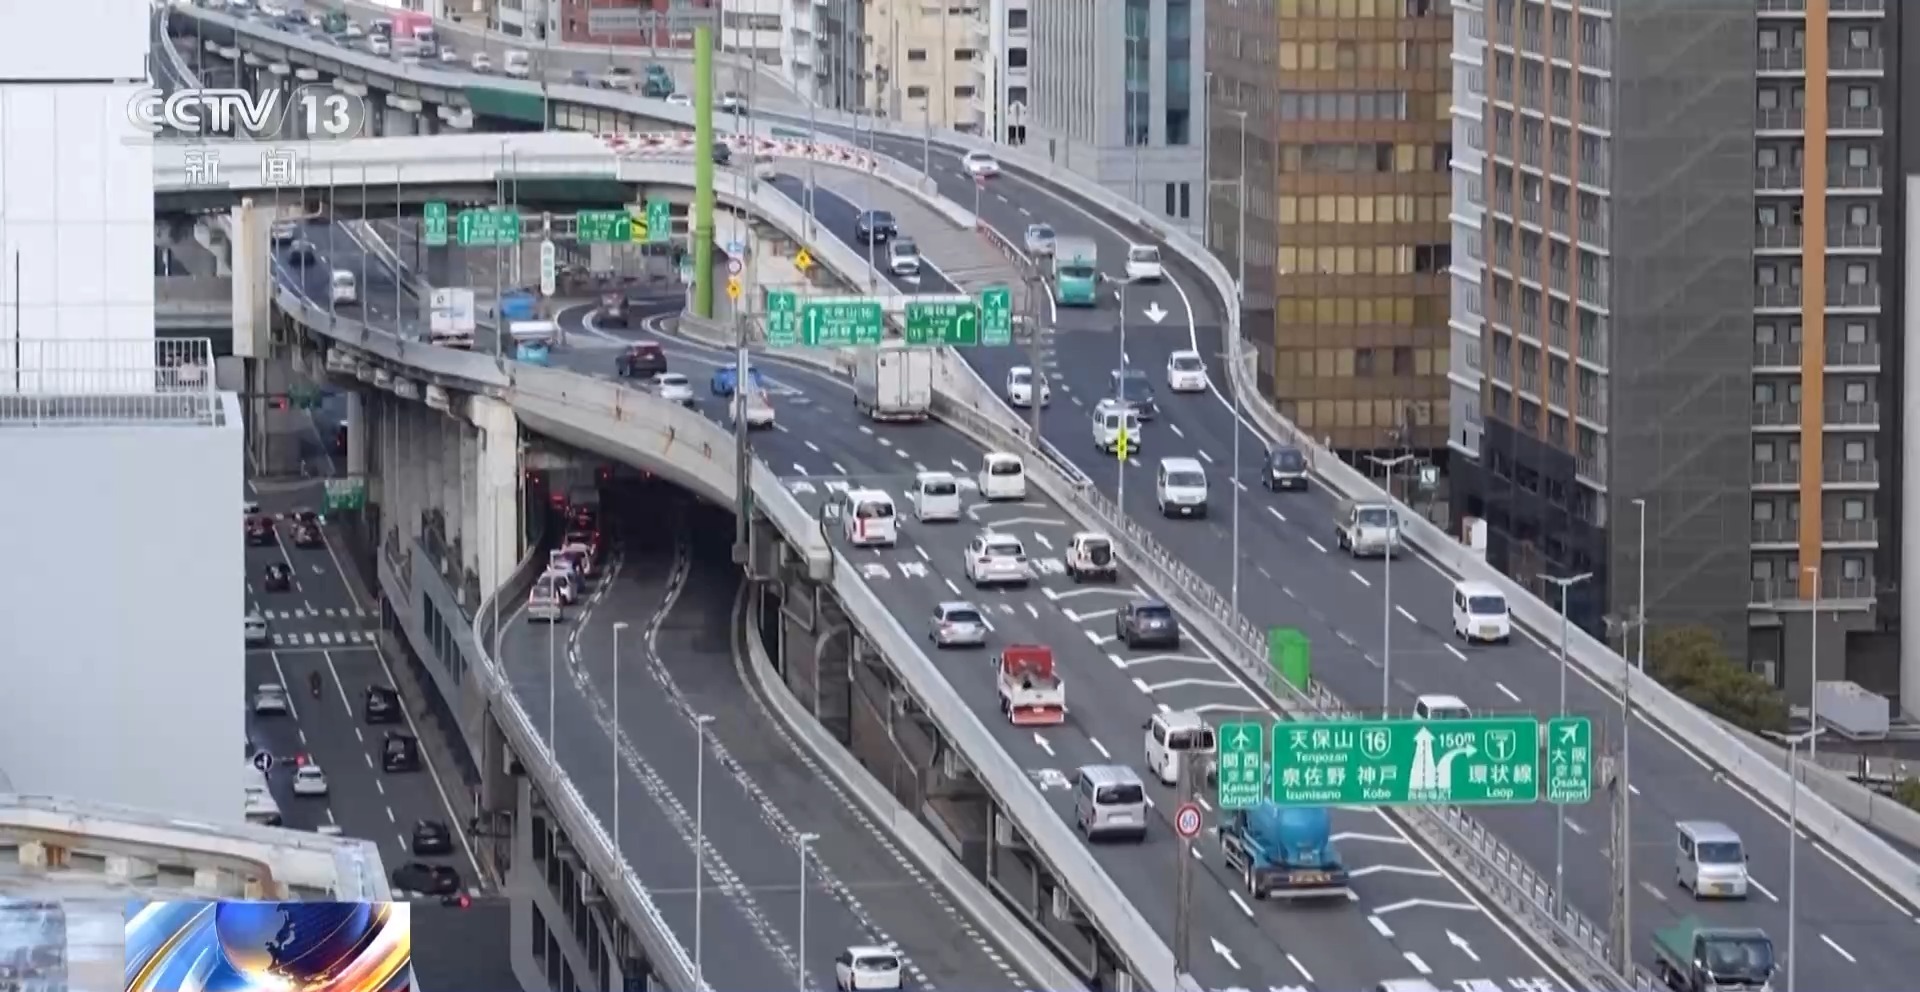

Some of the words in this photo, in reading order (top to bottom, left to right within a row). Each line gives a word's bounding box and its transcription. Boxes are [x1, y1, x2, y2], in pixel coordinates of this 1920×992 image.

[1289, 728, 1353, 750] 天保山
[1365, 731, 1386, 752] 16
[1439, 731, 1476, 748] 150m
[1496, 740, 1505, 759] 1
[1551, 747, 1587, 763] 大阪
[1296, 752, 1348, 764] Tenpozan
[1282, 766, 1346, 787] 泉佐野
[1357, 765, 1398, 786] 神戸
[1468, 764, 1532, 784] 環状線
[1551, 776, 1587, 787] Osaka
[1222, 782, 1260, 794] Kansai
[1286, 787, 1341, 800] Izumisano
[1363, 787, 1392, 799] Kobe
[1486, 786, 1514, 798] Loop
[1551, 788, 1587, 802] Airport
[1222, 793, 1260, 806] Airport
